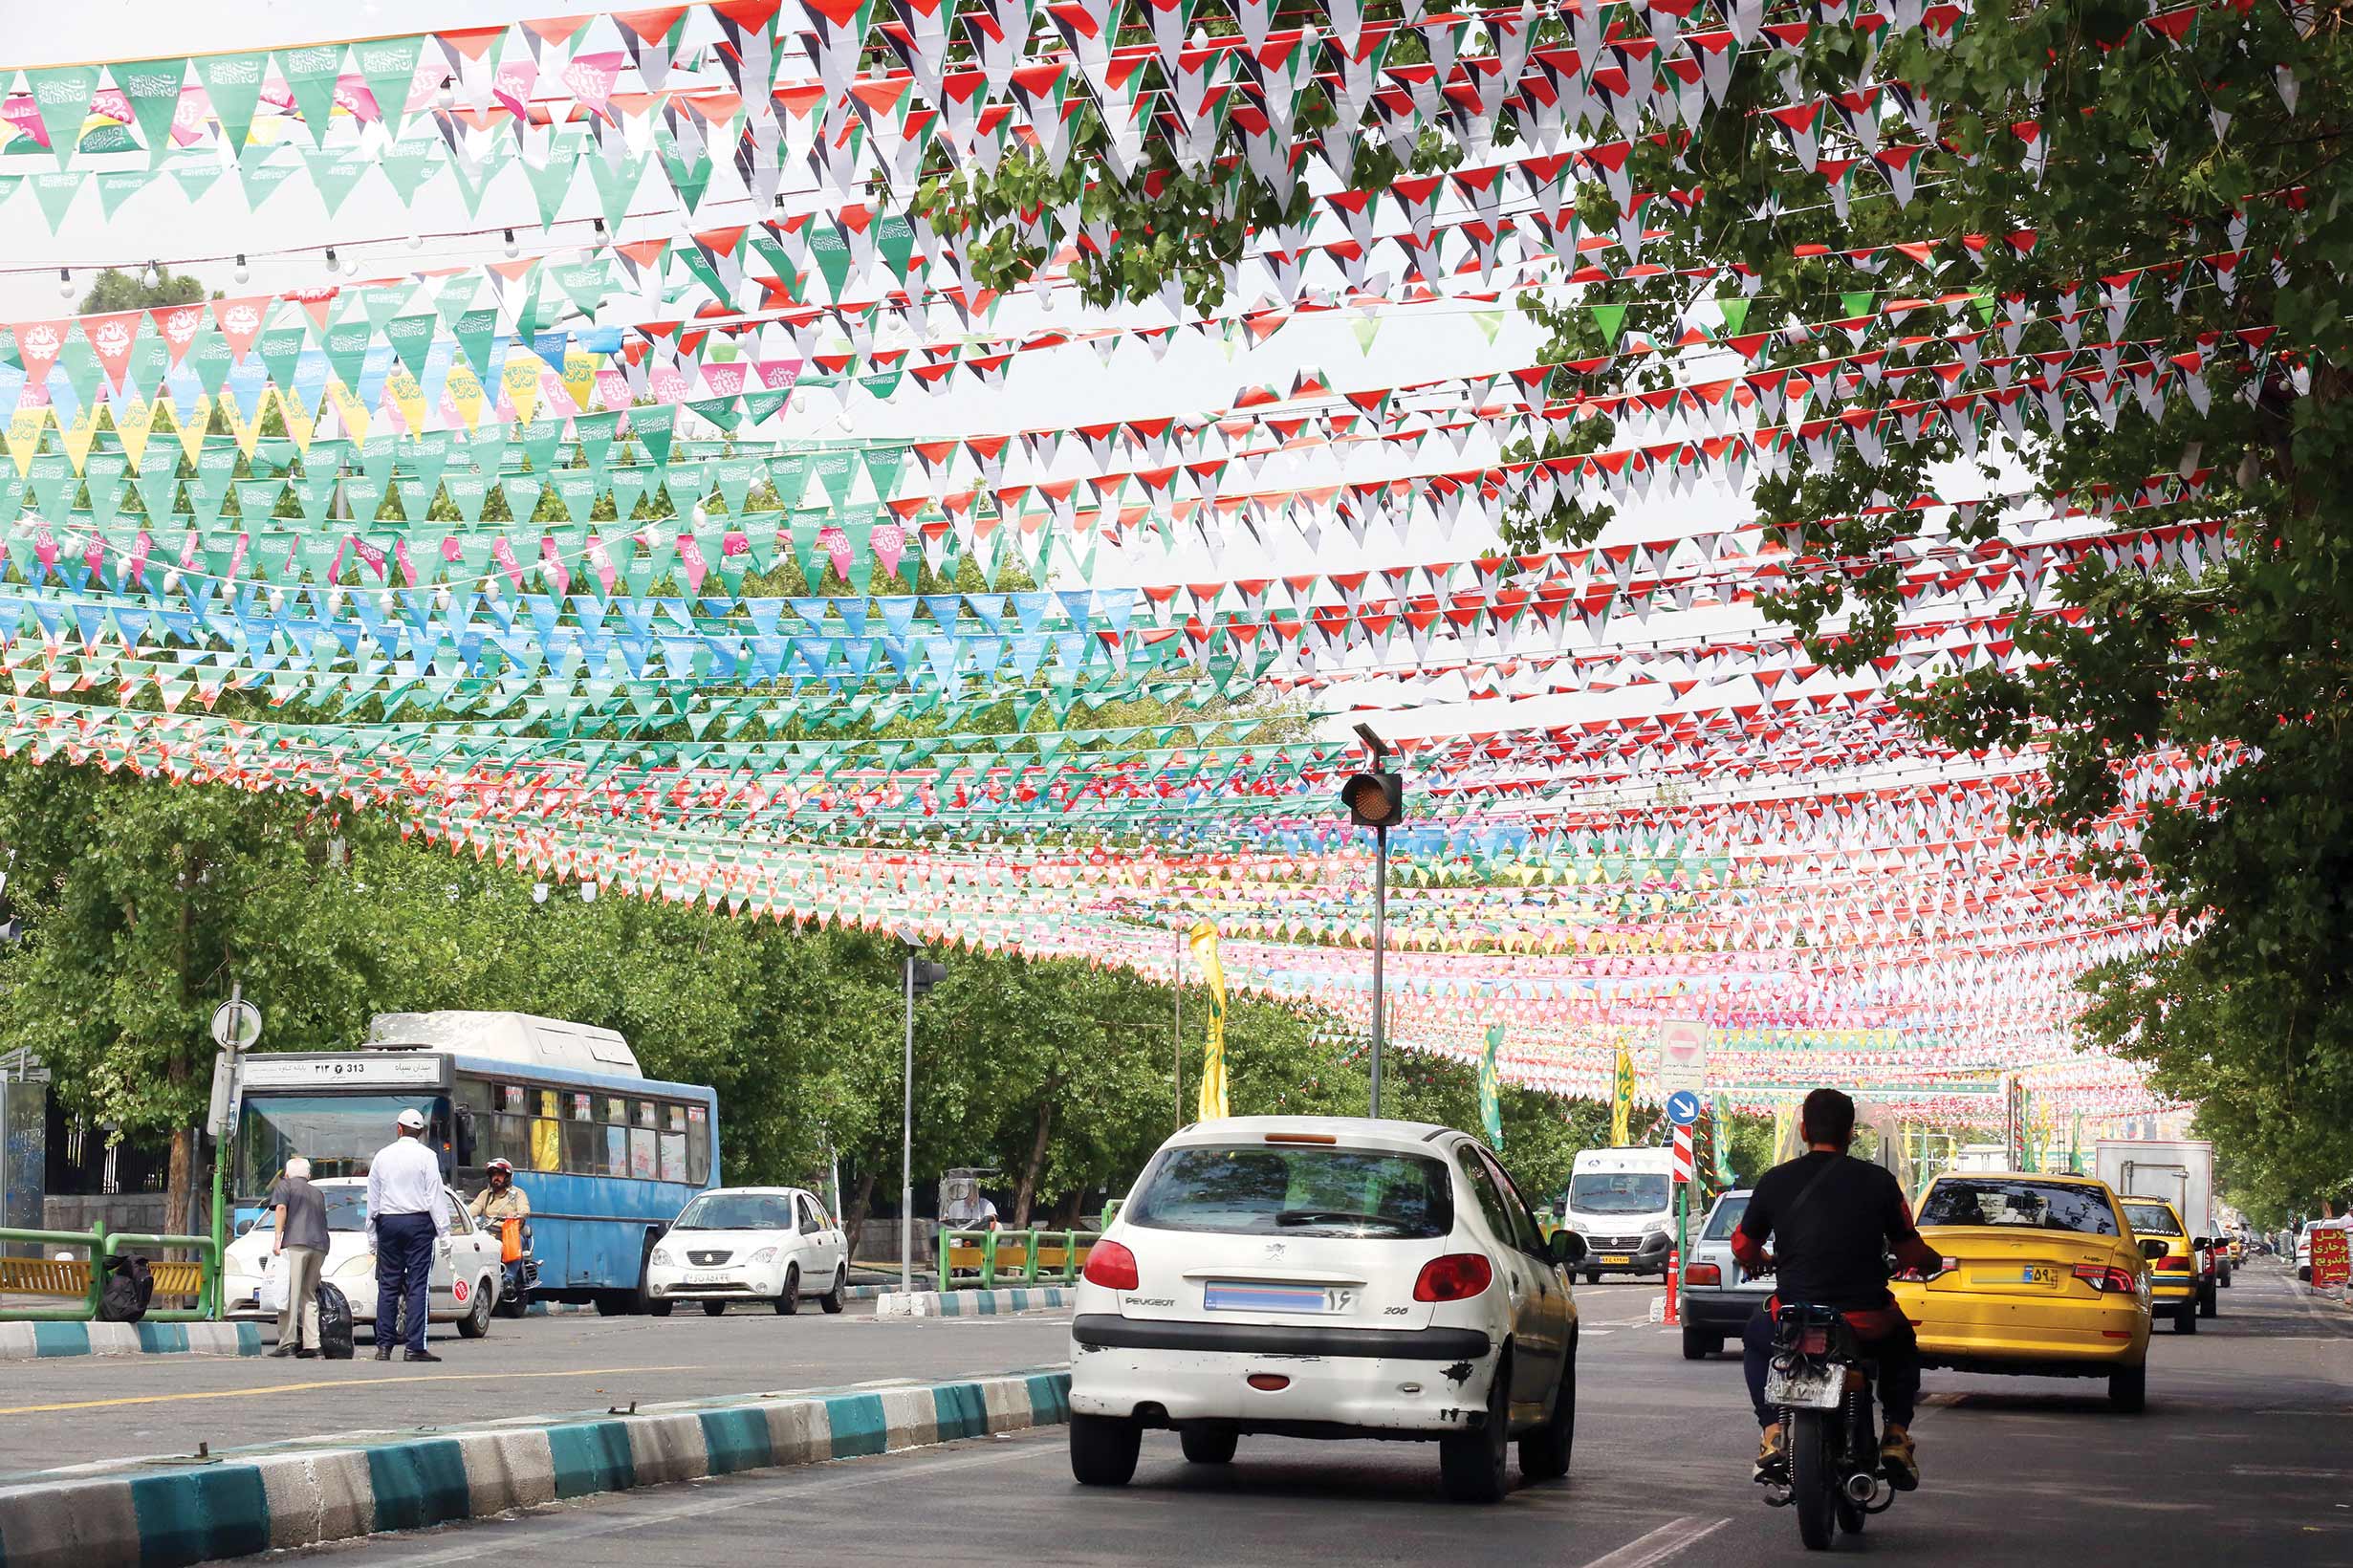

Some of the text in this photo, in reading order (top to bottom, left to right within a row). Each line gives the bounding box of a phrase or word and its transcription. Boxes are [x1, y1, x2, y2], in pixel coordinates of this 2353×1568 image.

[315, 1064, 330, 1073] ۳۱۳
[346, 1063, 364, 1073] 313
[2316, 1230, 2347, 1241] لافل
[2314, 1242, 2349, 1254] وخاری
[2034, 1269, 2050, 1282] ۵۹
[1124, 1297, 1176, 1307] PEUGEOT
[1328, 1291, 1352, 1311] ۱۶
